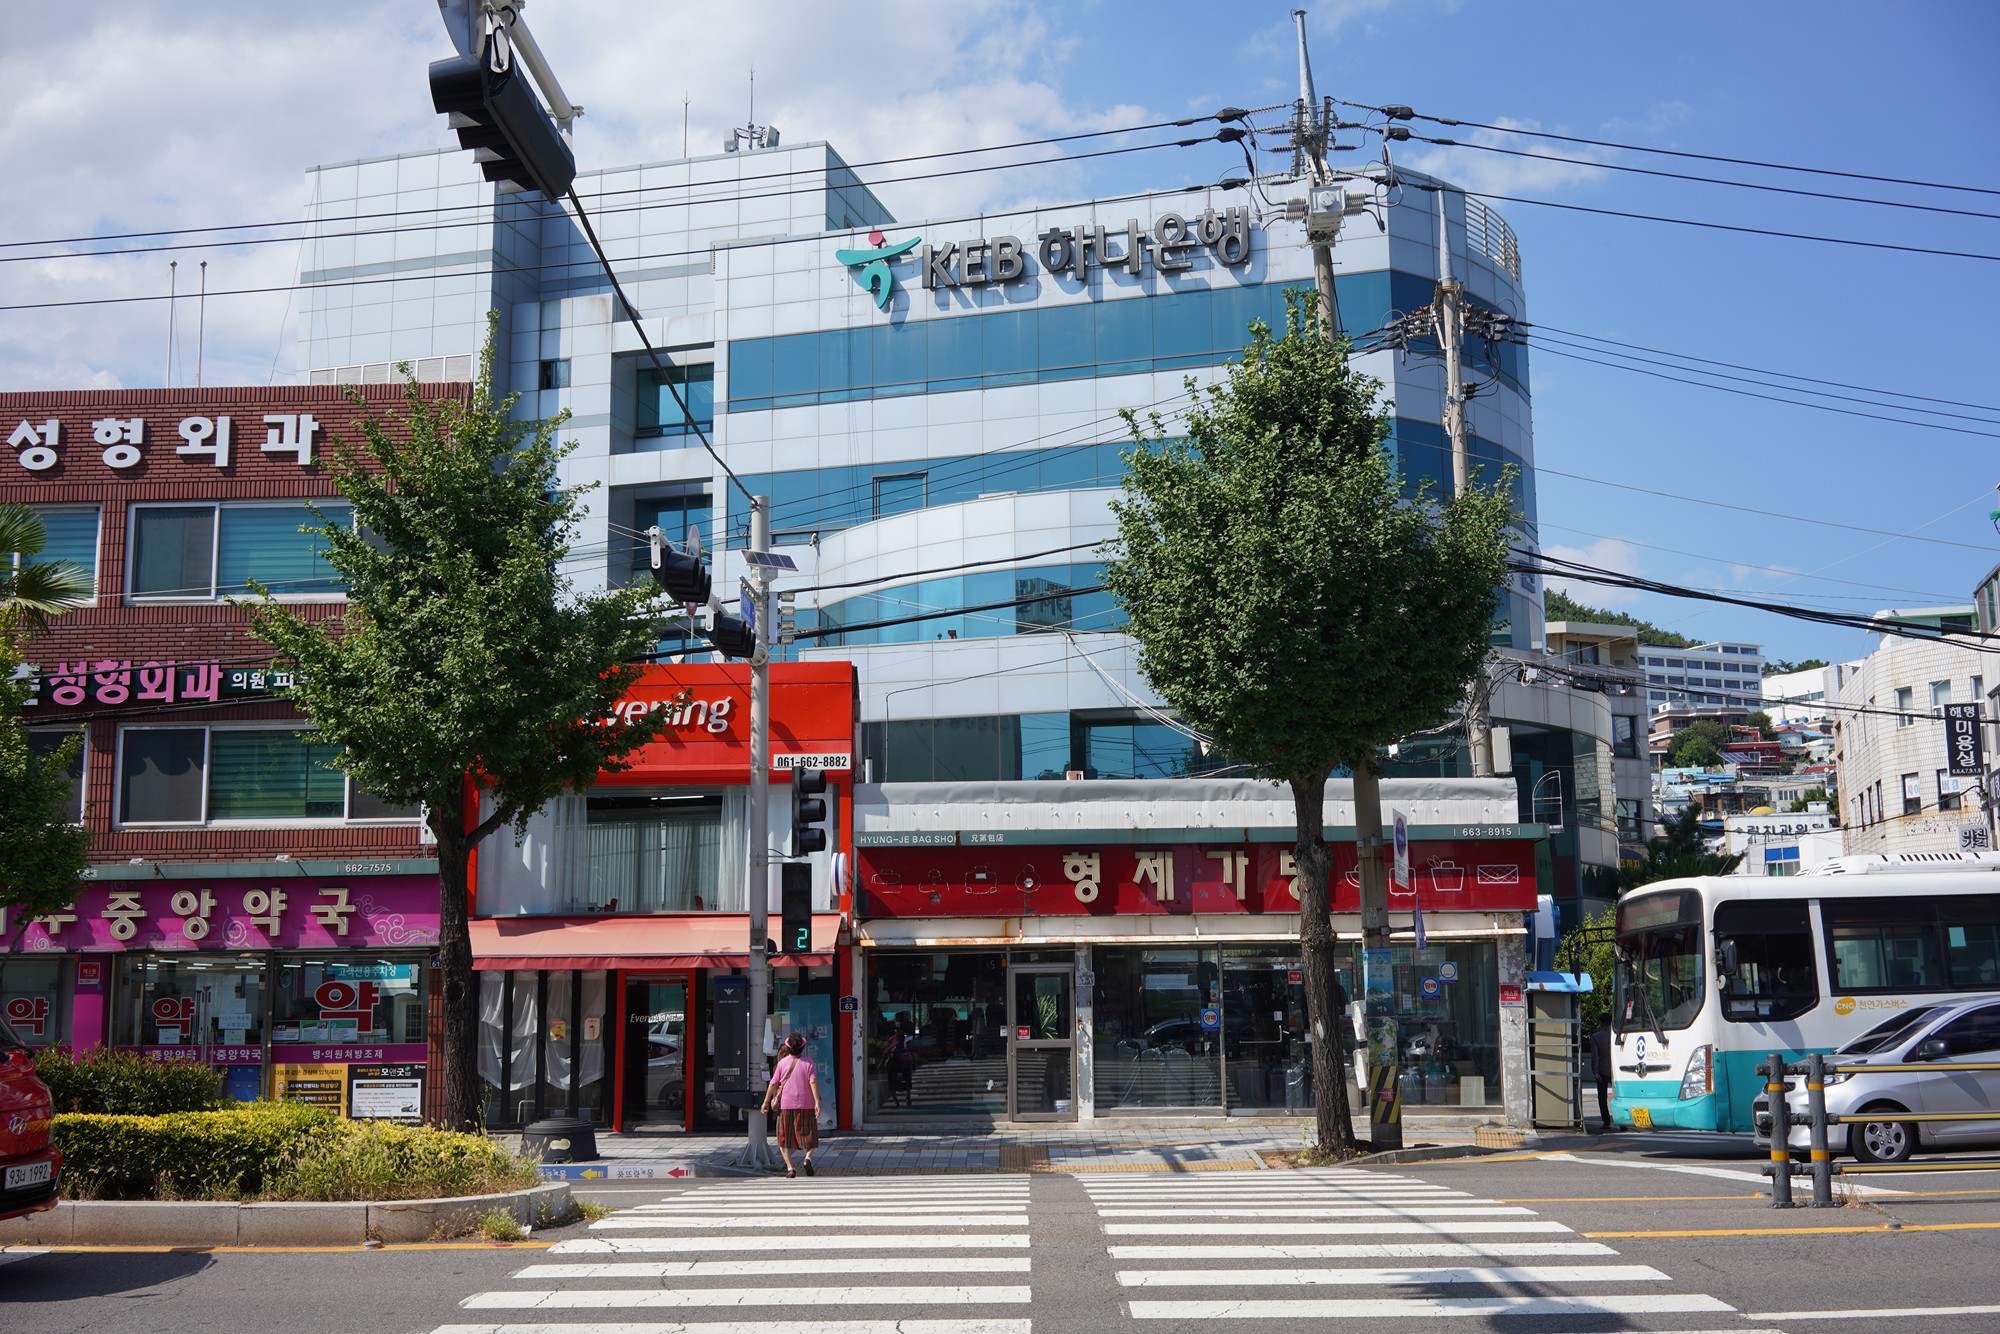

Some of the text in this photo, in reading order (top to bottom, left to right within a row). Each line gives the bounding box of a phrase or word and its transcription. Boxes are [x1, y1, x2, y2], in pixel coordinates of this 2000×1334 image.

[922, 205, 1249, 289] KEB 하나은행
[6, 414, 319, 471] 성형외과
[49, 659, 224, 706] 성형외과
[231, 672, 266, 689] 의원
[590, 693, 733, 733] vening
[1956, 720, 1976, 768] 미용실
[777, 756, 847, 767] 061-662-8882
[860, 836, 910, 844] HYUNG-JE
[912, 835, 932, 843] BAG
[1462, 828, 1512, 836] 663-8915
[345, 864, 391, 873] 662-7575
[797, 928, 808, 949] 2
[6, 997, 50, 1036] 약
[152, 996, 197, 1036] 약
[314, 980, 381, 1033] 약
[1836, 999, 1908, 1010] CNG 천연가스버스
[216, 1049, 262, 1060] 중앙약국
[10, 1164, 48, 1185] 93너 1992
